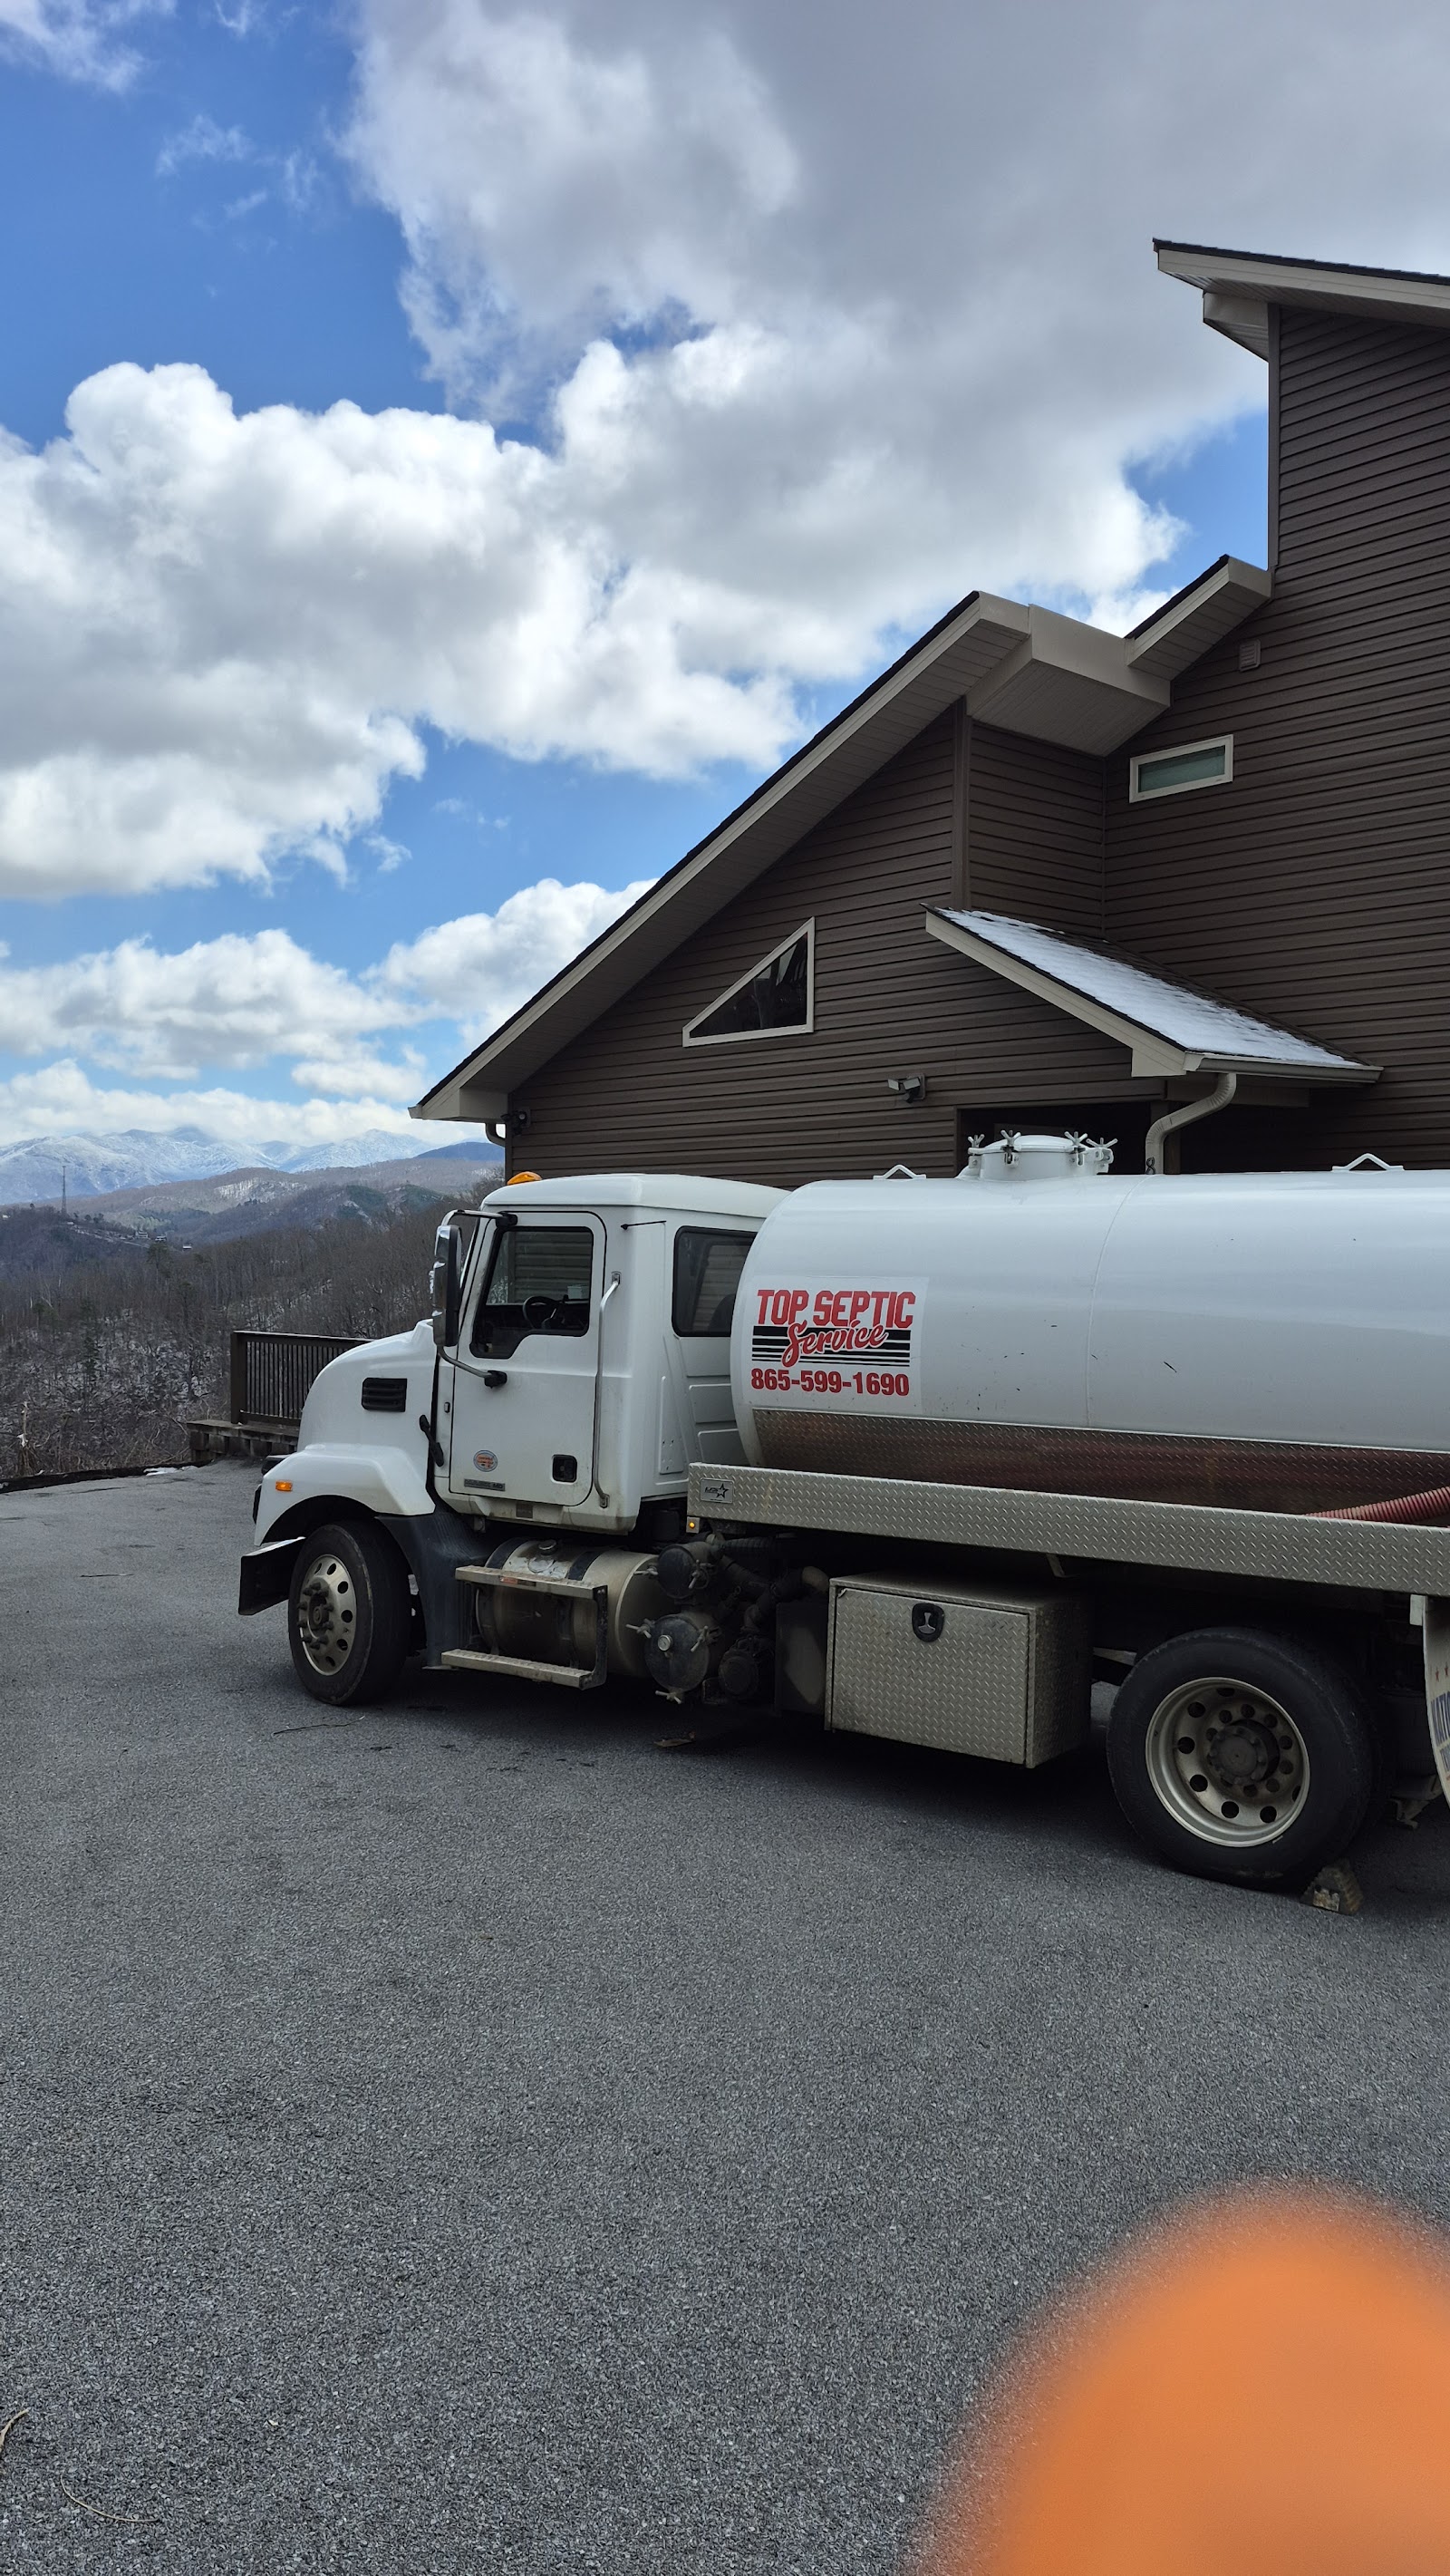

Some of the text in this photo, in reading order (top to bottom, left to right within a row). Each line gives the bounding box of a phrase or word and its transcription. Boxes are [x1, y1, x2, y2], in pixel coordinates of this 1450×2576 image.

[758, 1290, 916, 1329] TOP SEPTIC
[782, 1320, 887, 1367] Service
[751, 1369, 909, 1396] 865-599-1690
